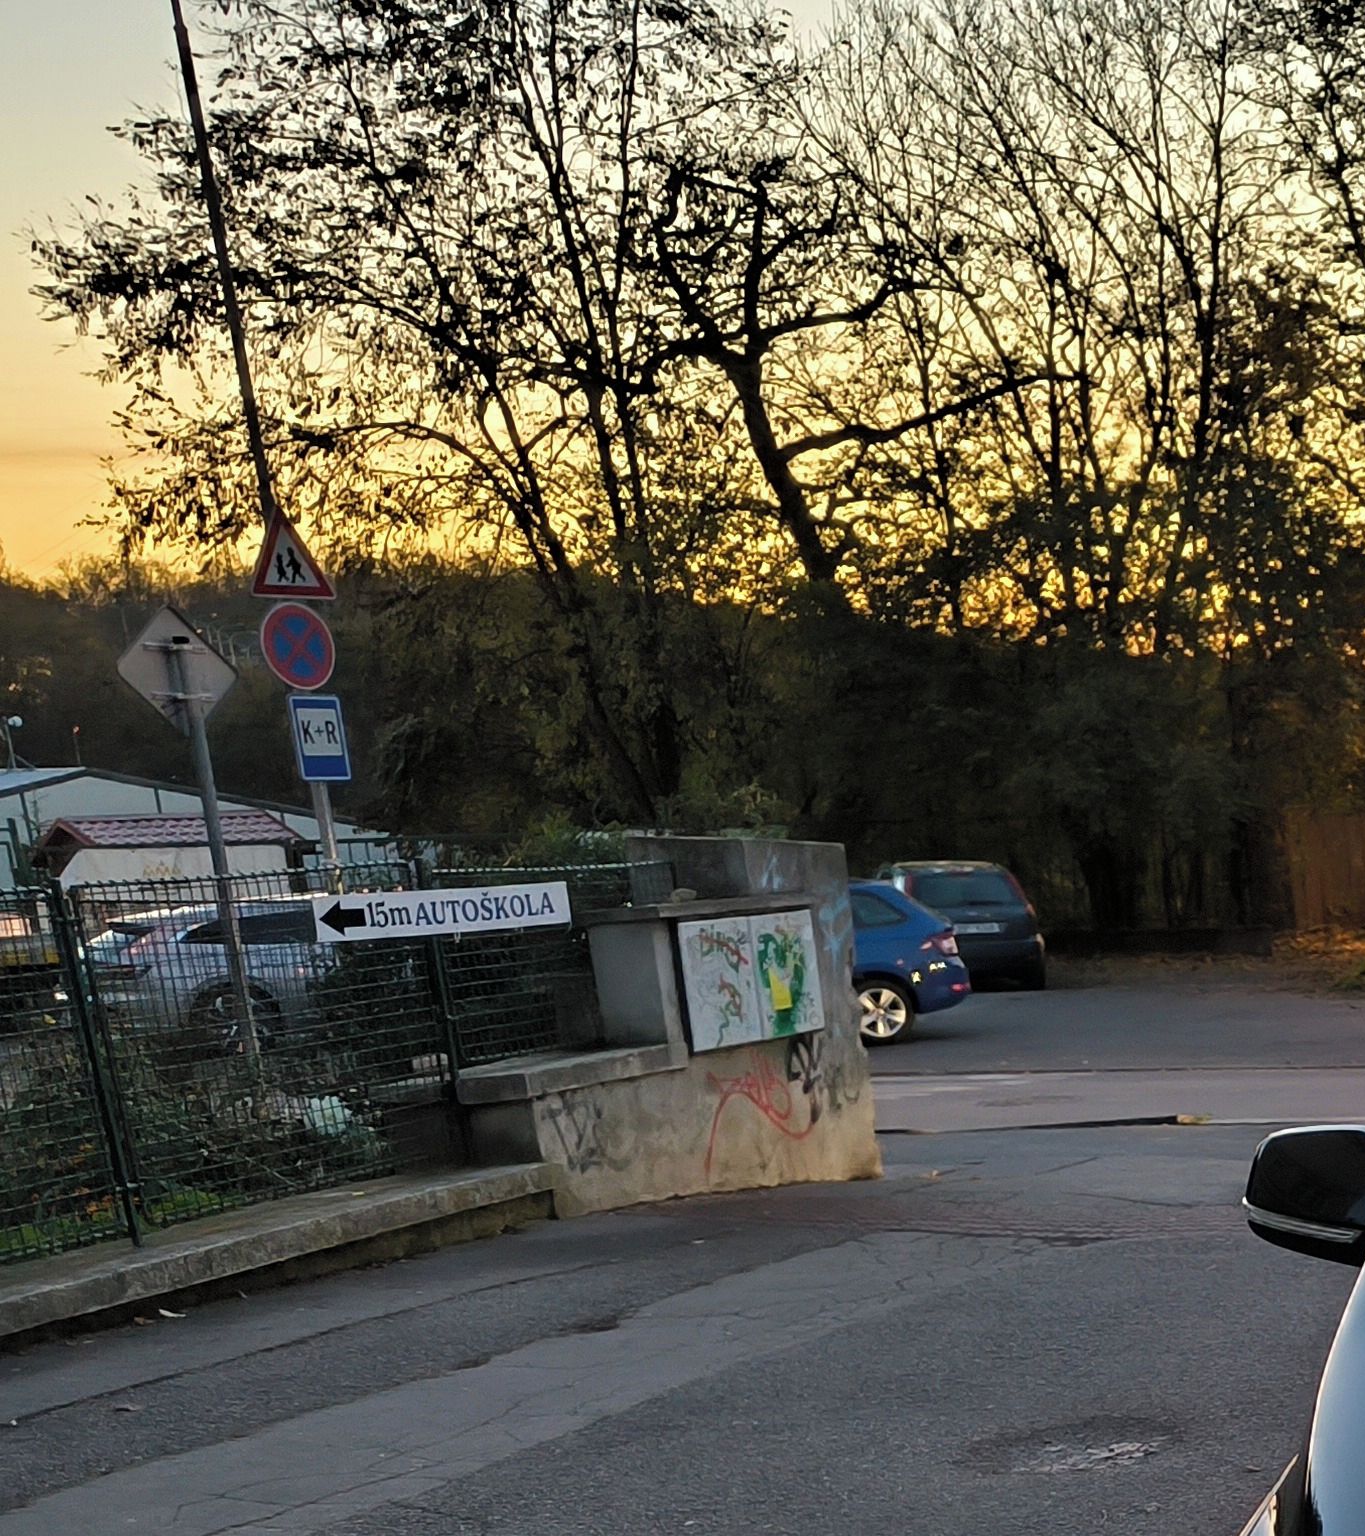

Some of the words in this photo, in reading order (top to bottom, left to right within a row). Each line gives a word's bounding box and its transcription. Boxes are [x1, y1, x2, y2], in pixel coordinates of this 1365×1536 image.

[301, 720, 338, 744] K+R
[366, 901, 412, 928] 15m
[415, 892, 555, 926] AUTOŠKOLA
